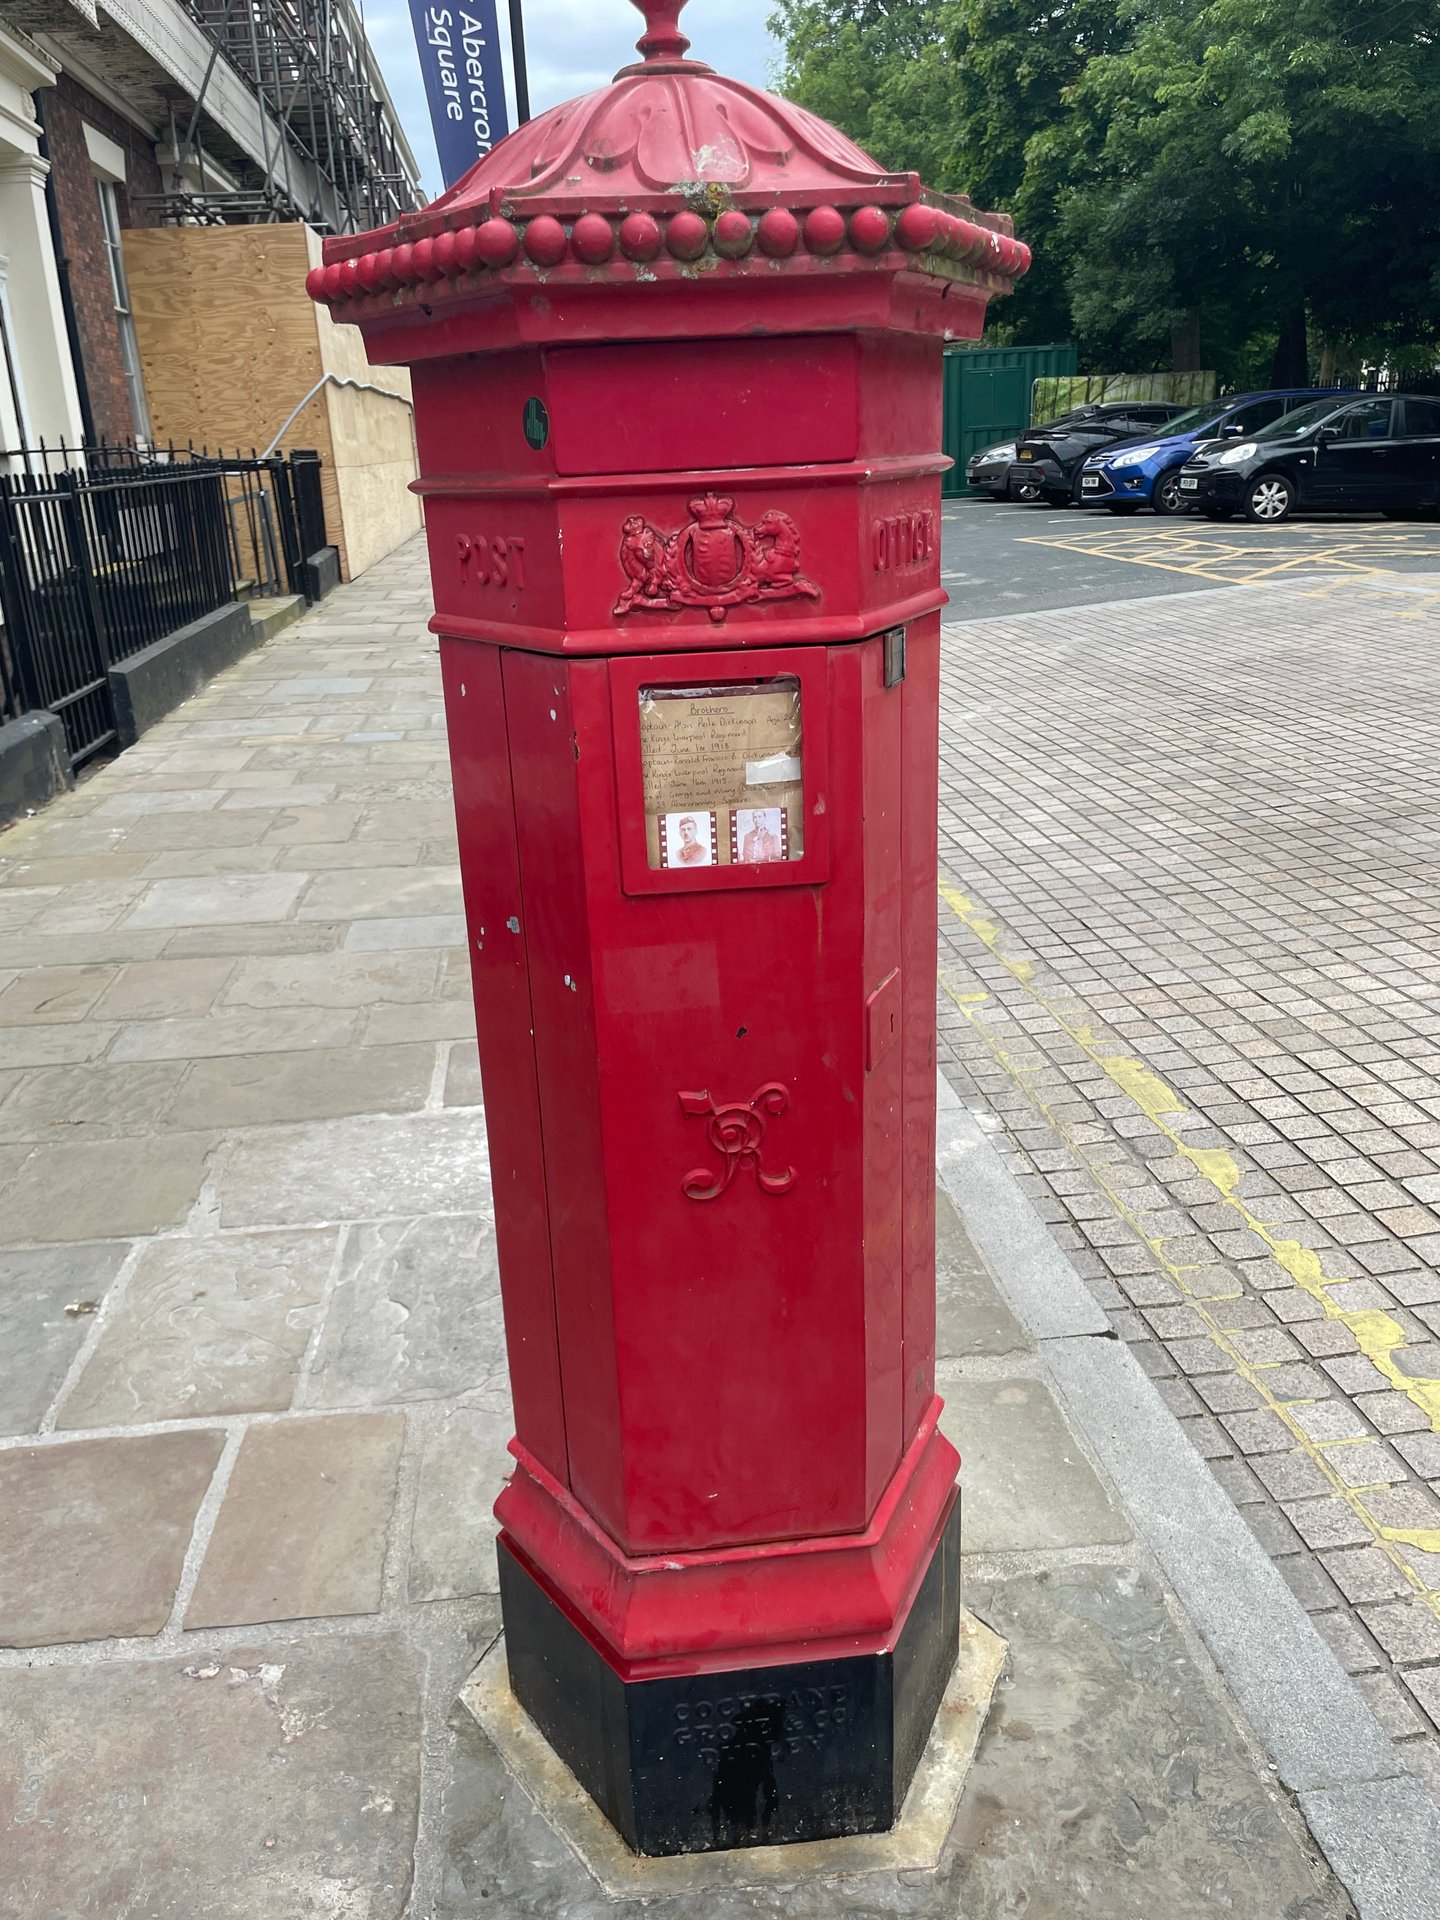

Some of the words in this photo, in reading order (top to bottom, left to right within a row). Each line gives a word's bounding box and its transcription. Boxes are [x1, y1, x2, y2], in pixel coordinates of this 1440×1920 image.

[428, 7, 464, 121] Square
[455, 533, 526, 591] POST
[690, 703, 728, 715] Brothers
[673, 732, 706, 742] Liverpool
[711, 729, 747, 742] Regiment
[670, 743, 690, 753] June
[674, 767, 708, 778] Liverpool
[670, 780, 687, 788] June
[669, 791, 693, 799] George
